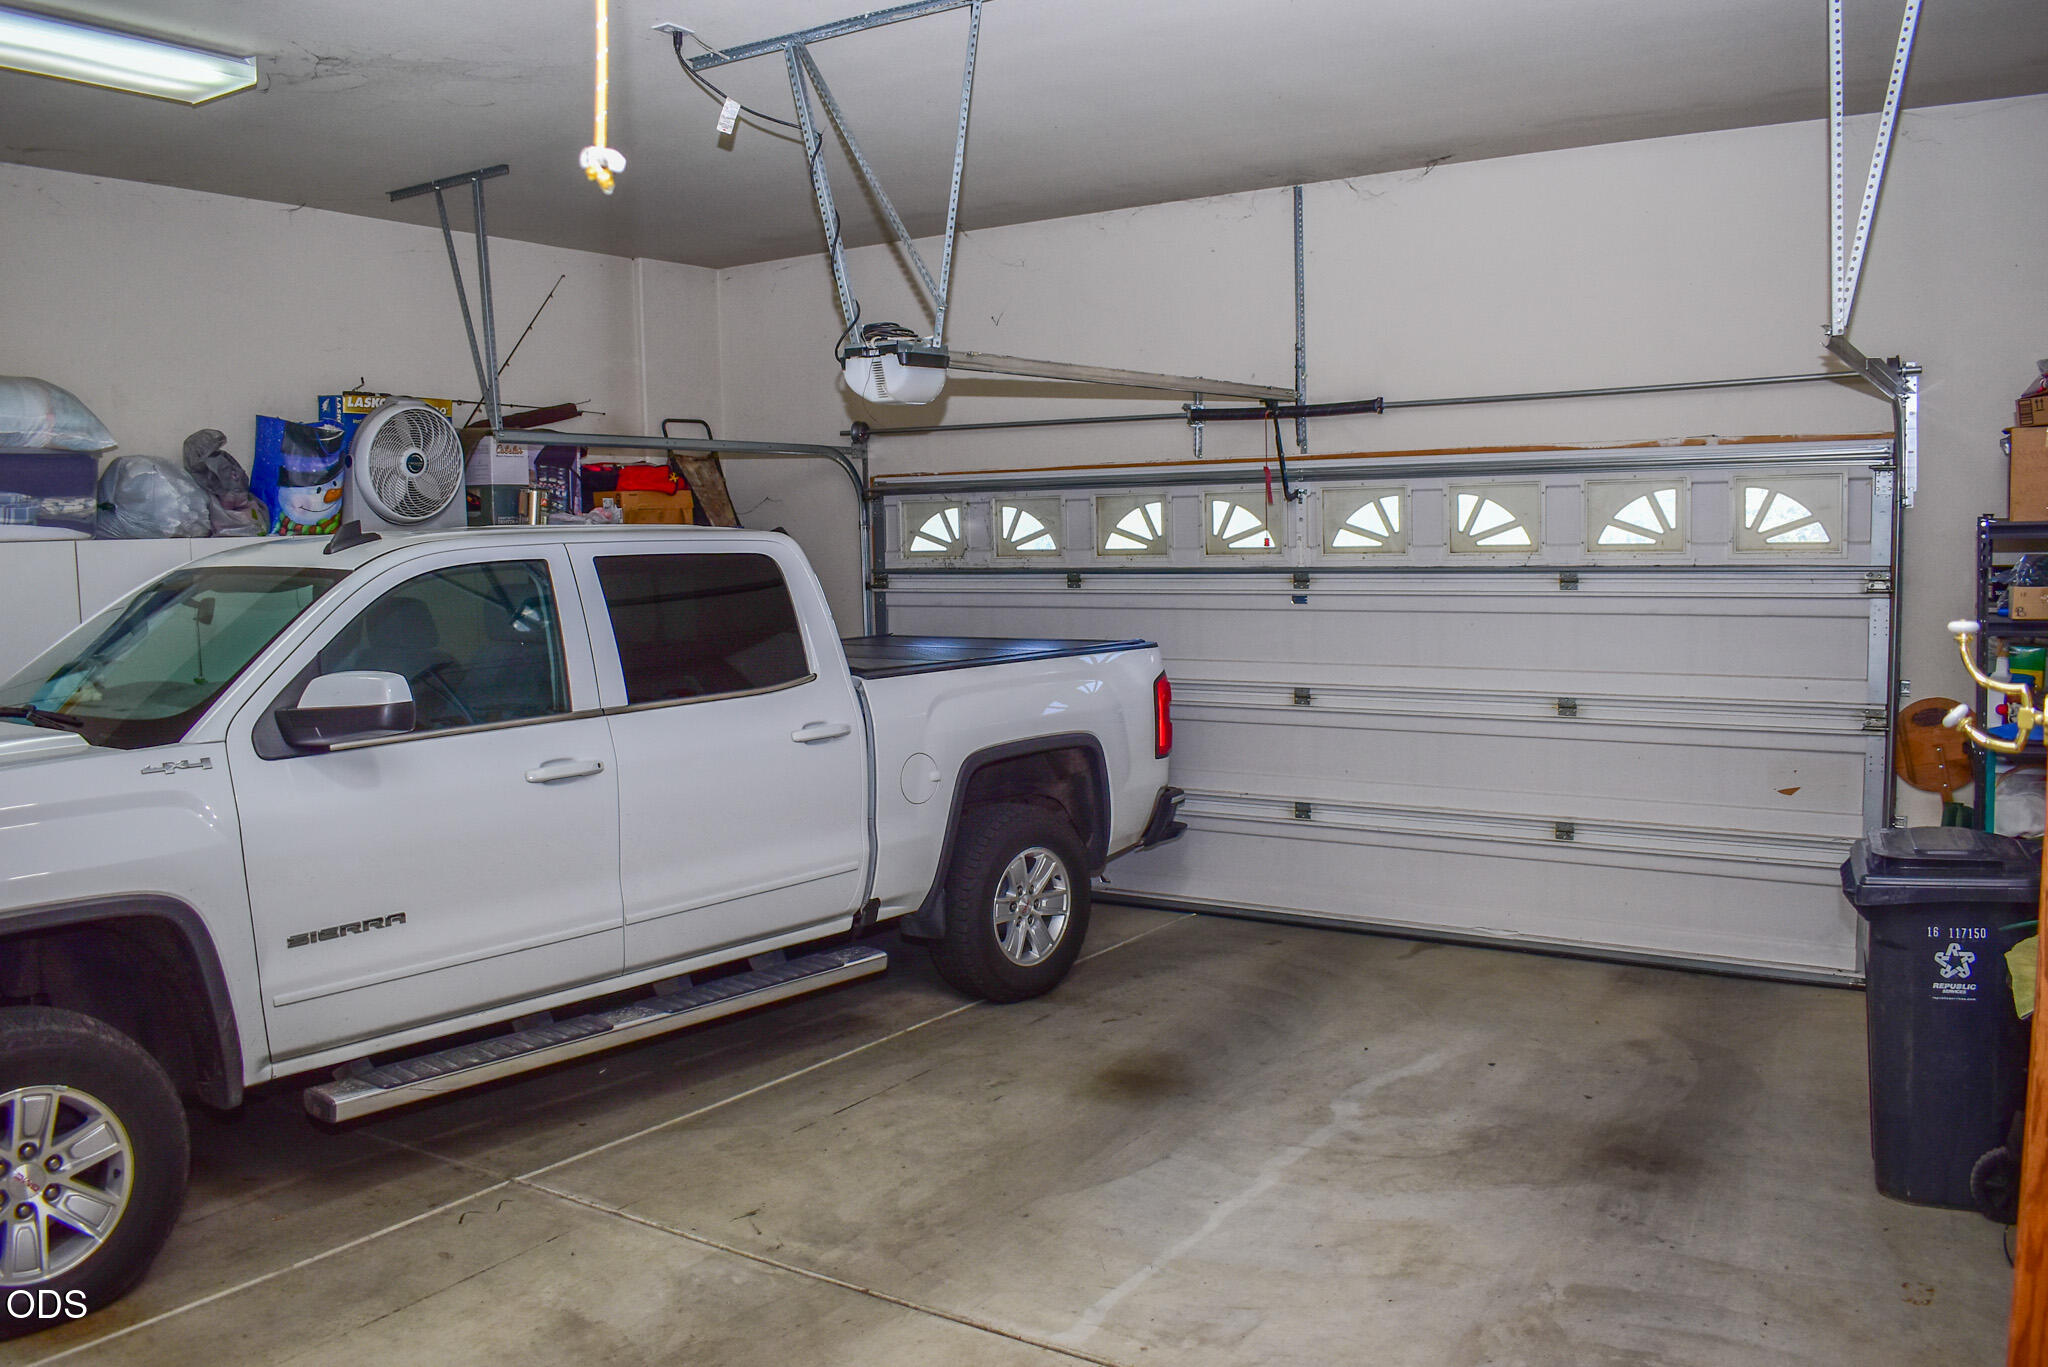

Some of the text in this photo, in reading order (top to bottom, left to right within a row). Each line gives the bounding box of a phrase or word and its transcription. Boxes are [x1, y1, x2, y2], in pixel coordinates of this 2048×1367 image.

[286, 912, 406, 948] SIERRA
[1927, 926, 1987, 939] 16 117150
[1932, 982, 1977, 990] REPUBLIC
